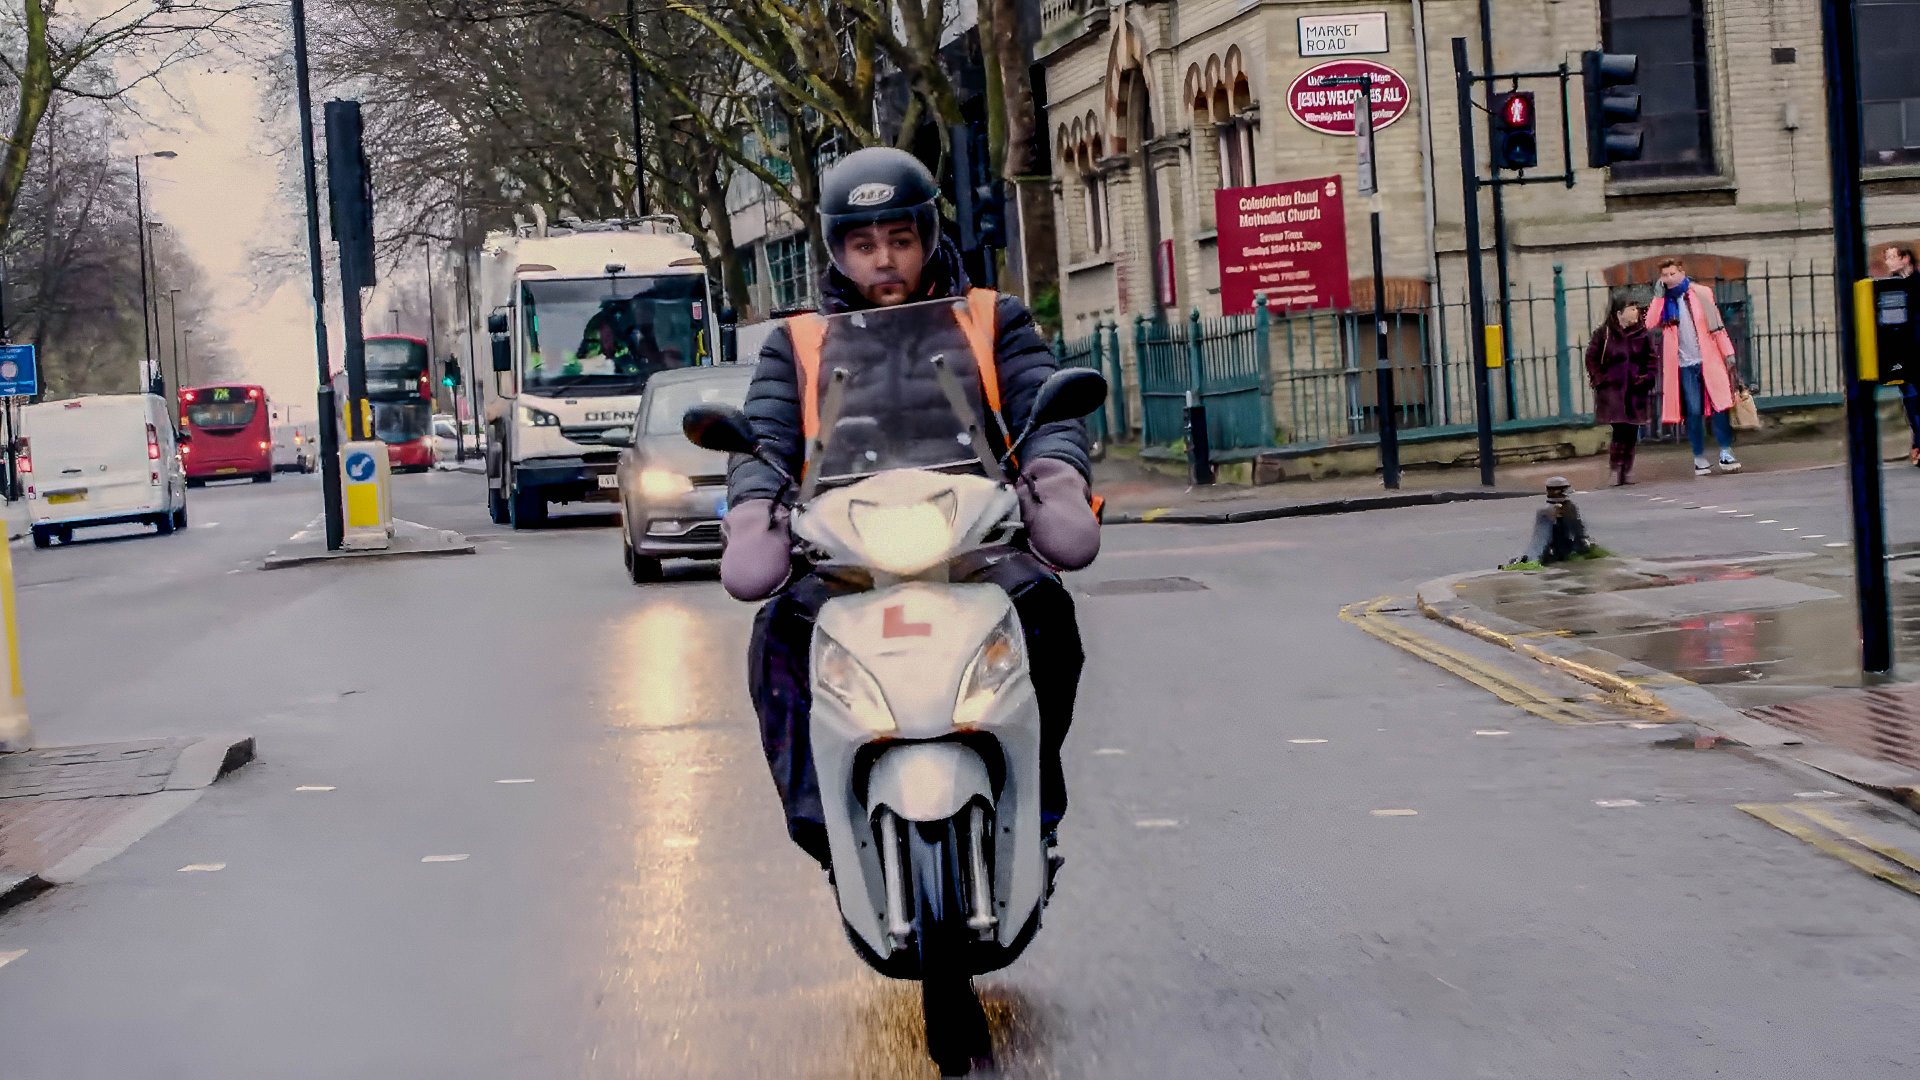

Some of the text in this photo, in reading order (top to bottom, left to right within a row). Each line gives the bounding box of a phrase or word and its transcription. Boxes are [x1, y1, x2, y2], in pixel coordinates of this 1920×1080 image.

[1306, 24, 1359, 38] MARKET
[1307, 38, 1346, 51] ROAD
[1297, 87, 1402, 110] JESUS WELCOES ALL
[1239, 189, 1318, 211] Caledonian Road
[1239, 206, 1320, 227] Methodist Church
[882, 605, 932, 639] L
